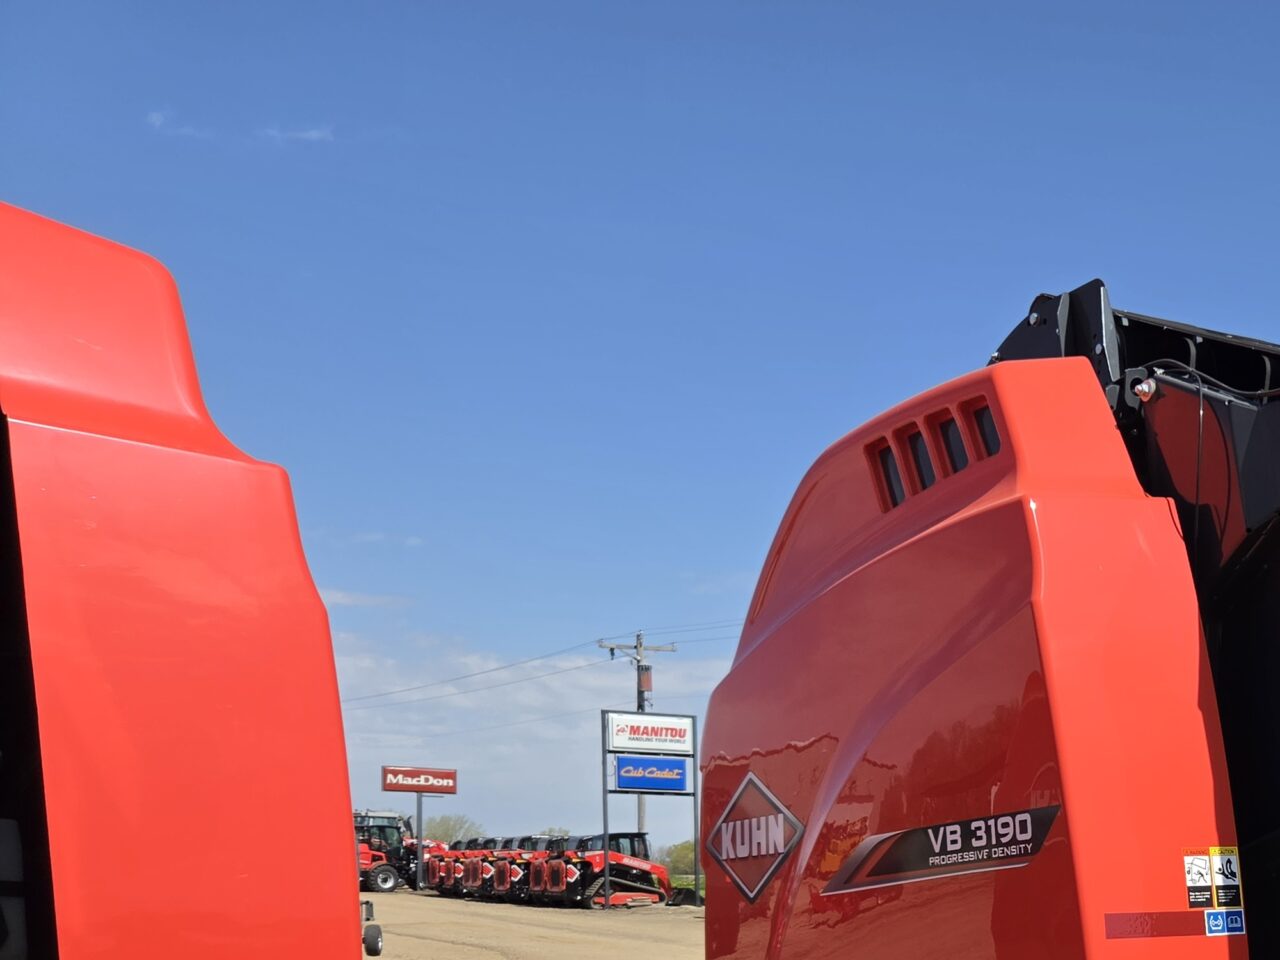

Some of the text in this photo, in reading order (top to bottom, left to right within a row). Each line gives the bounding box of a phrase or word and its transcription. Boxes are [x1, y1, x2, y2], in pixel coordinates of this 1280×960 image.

[629, 725, 687, 738] MANITOU
[386, 773, 454, 786] MacDon
[621, 766, 682, 778] Cub Cadet
[721, 813, 785, 860] KUHN
[928, 812, 1033, 853] VB 3190
[929, 843, 1033, 866] PROGRESSIVE DENSITY
